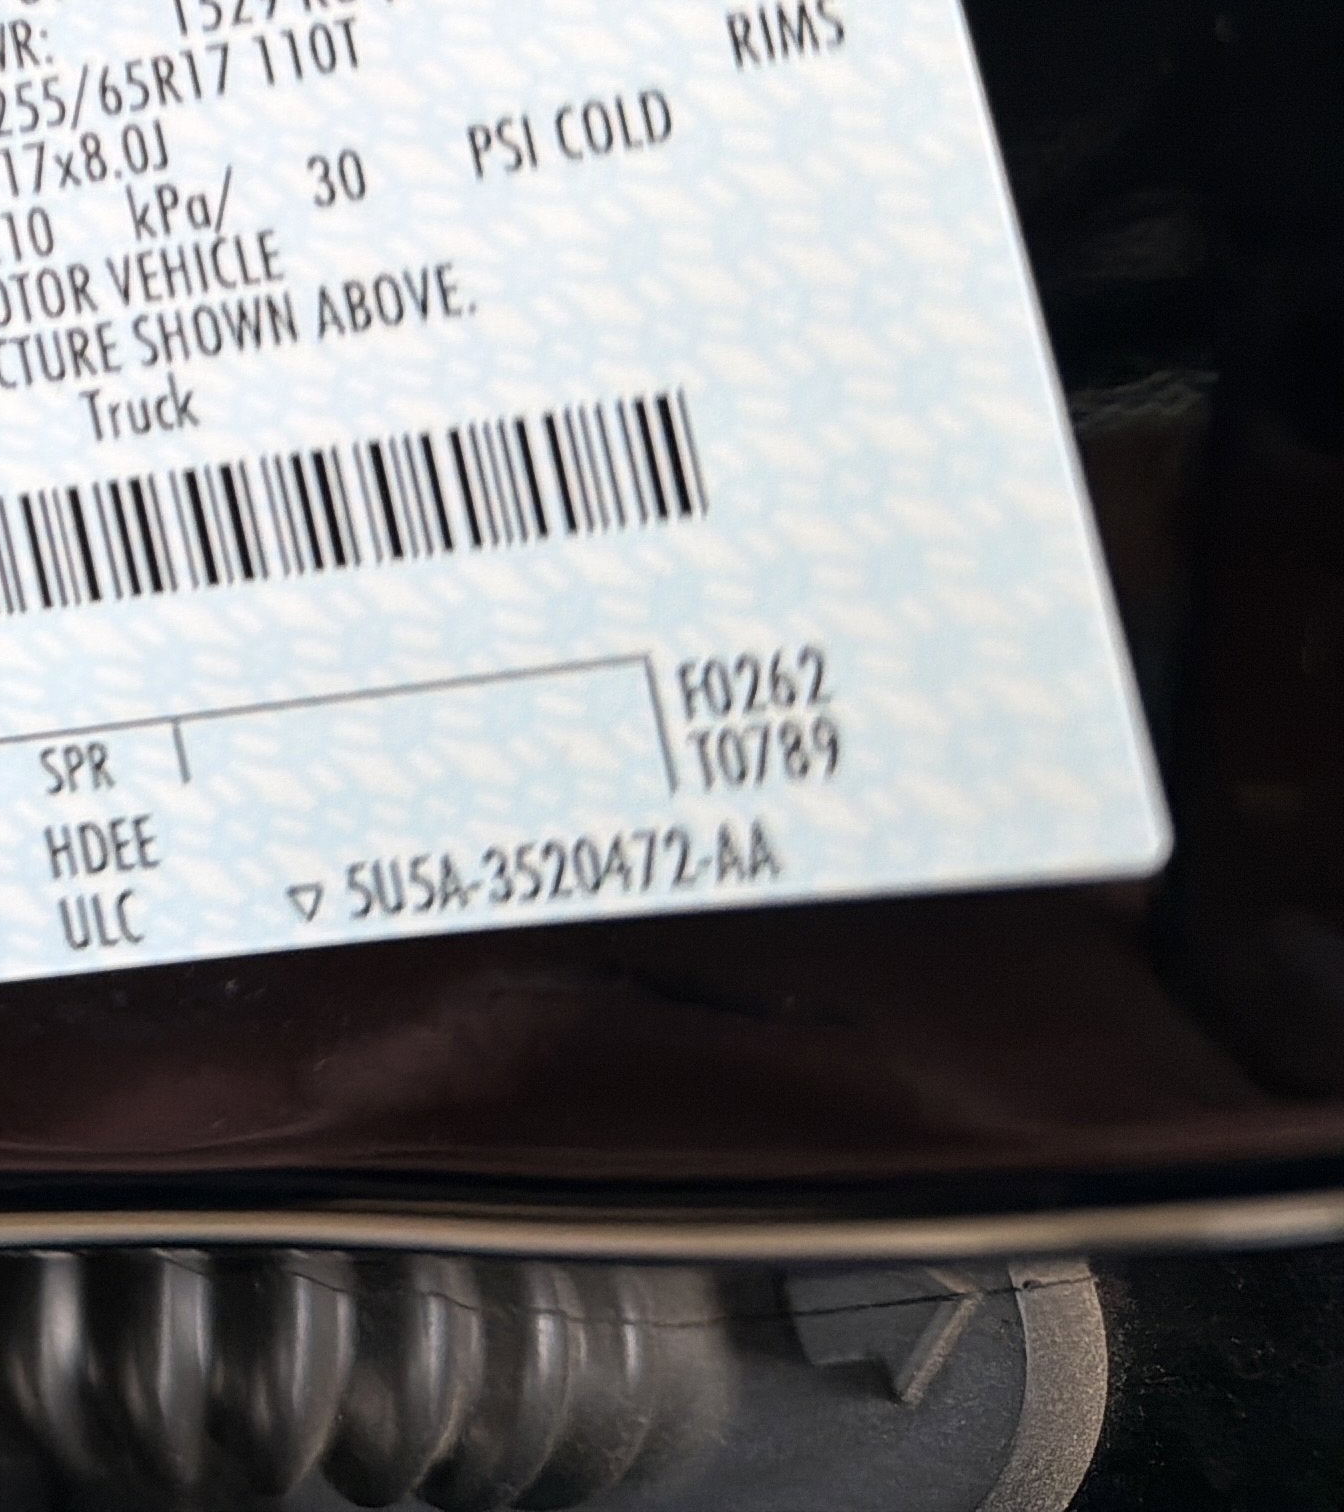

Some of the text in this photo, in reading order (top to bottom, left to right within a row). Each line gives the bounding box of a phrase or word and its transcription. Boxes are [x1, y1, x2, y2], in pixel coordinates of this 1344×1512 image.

[254, 15, 359, 85] 110T
[0, 117, 169, 197] 17x8.0J
[124, 164, 233, 241] kPa/
[305, 147, 367, 208] 30
[465, 113, 538, 179] PSI
[553, 88, 673, 160] COLD
[104, 228, 284, 307] VEHICLE
[130, 292, 299, 367] SHOWN
[316, 262, 476, 340] ABOVE.
[77, 374, 200, 442] Truck
[38, 740, 116, 795] SPR
[42, 812, 161, 881] HDEE
[55, 887, 145, 952] ULC
